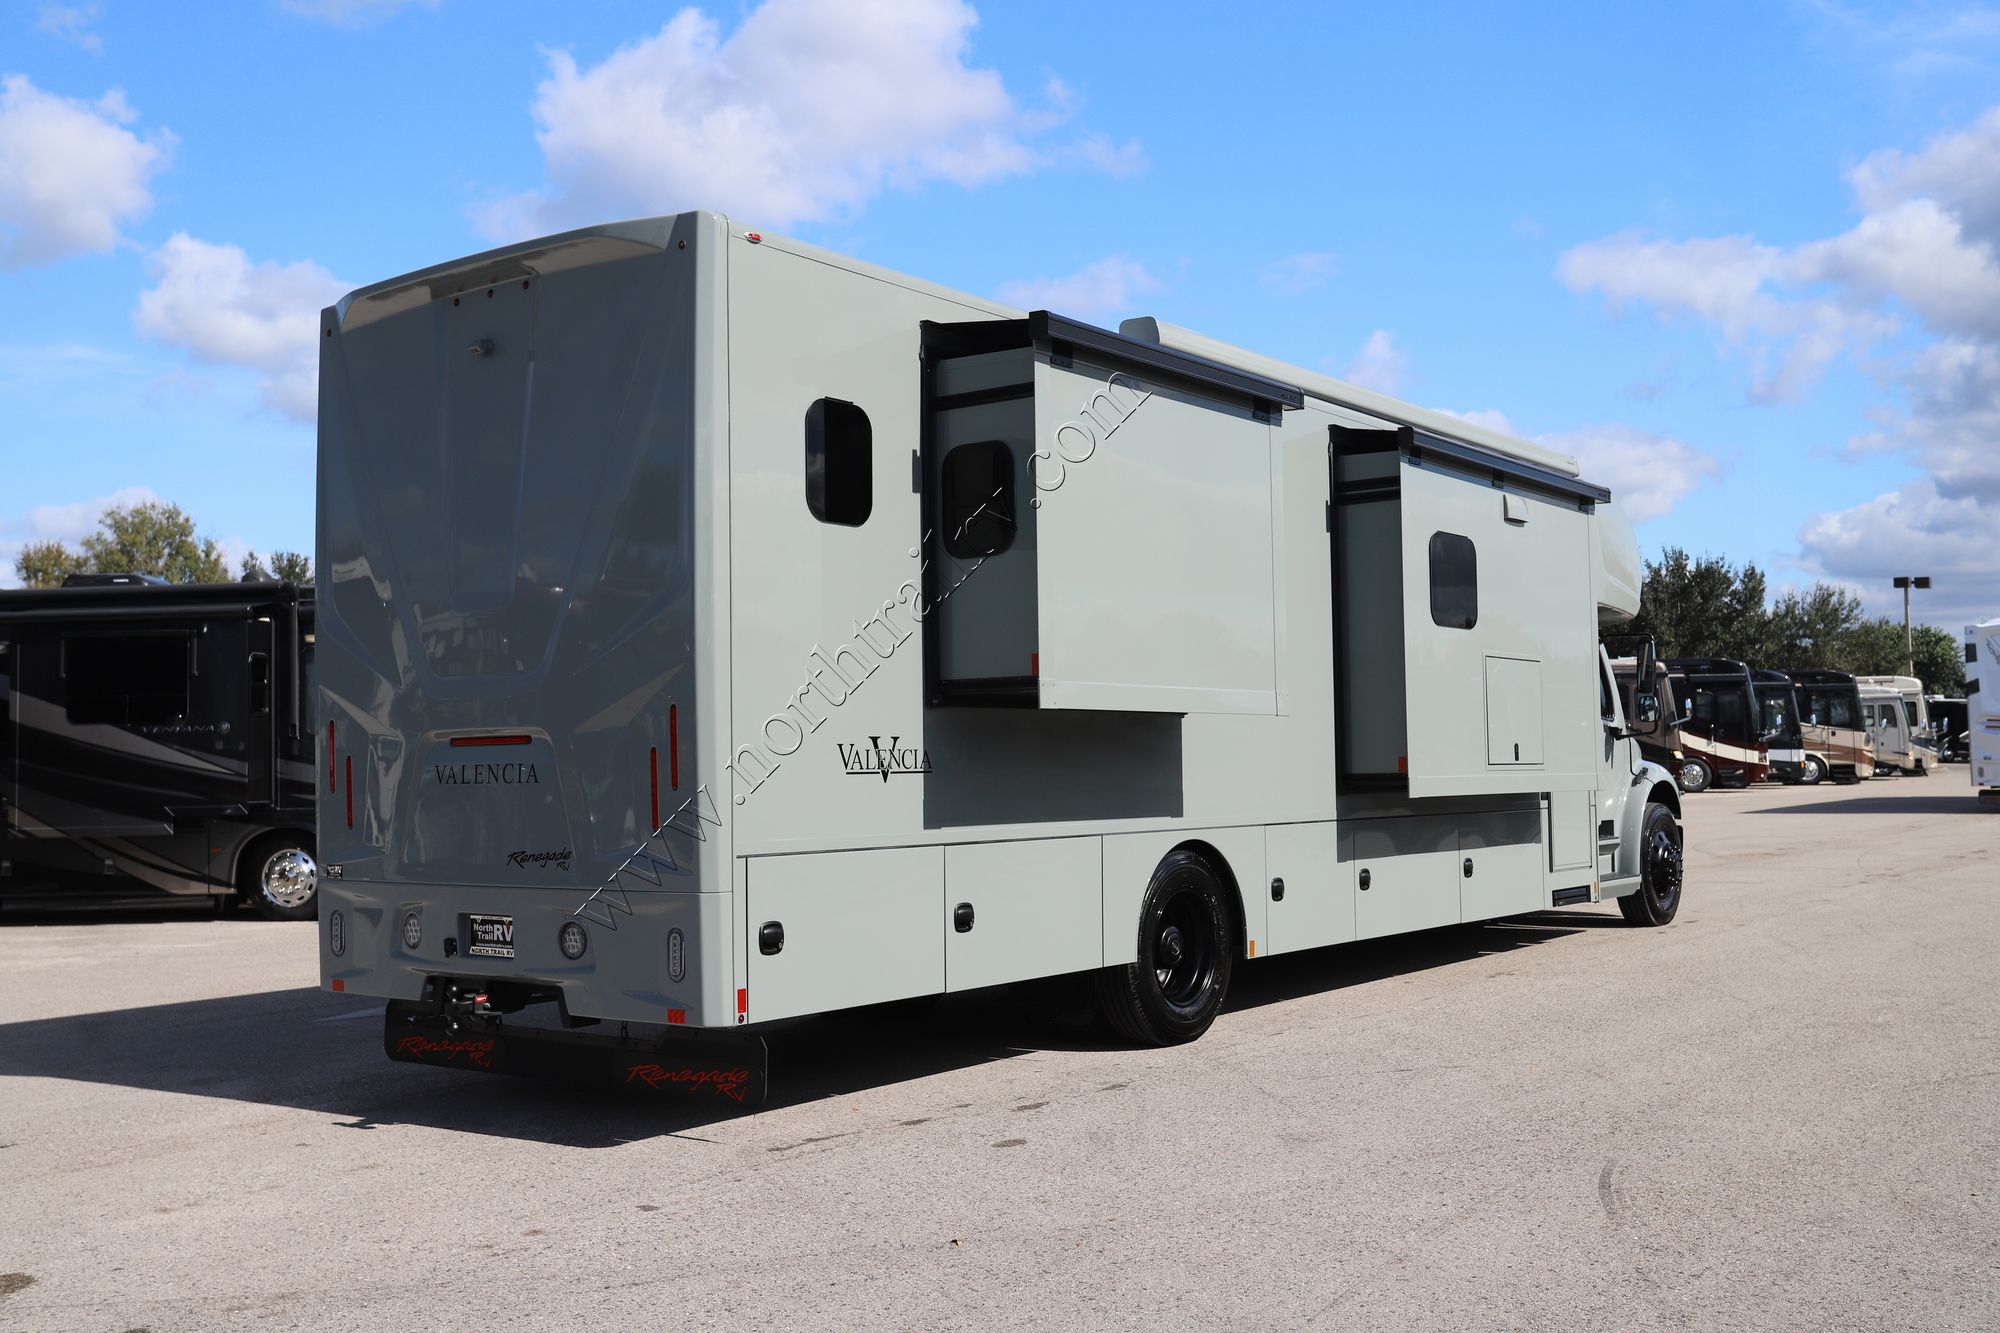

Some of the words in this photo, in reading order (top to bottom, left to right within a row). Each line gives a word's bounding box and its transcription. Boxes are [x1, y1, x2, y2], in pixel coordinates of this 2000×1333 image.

[435, 763, 539, 785] VALENCIA
[507, 847, 572, 869] Renegade
[556, 861, 571, 872] RV
[473, 923, 493, 932] North
[477, 931, 494, 940] Trail
[493, 924, 513, 941] RV
[396, 1035, 496, 1059] Renegade
[626, 1064, 750, 1089] Renegade
